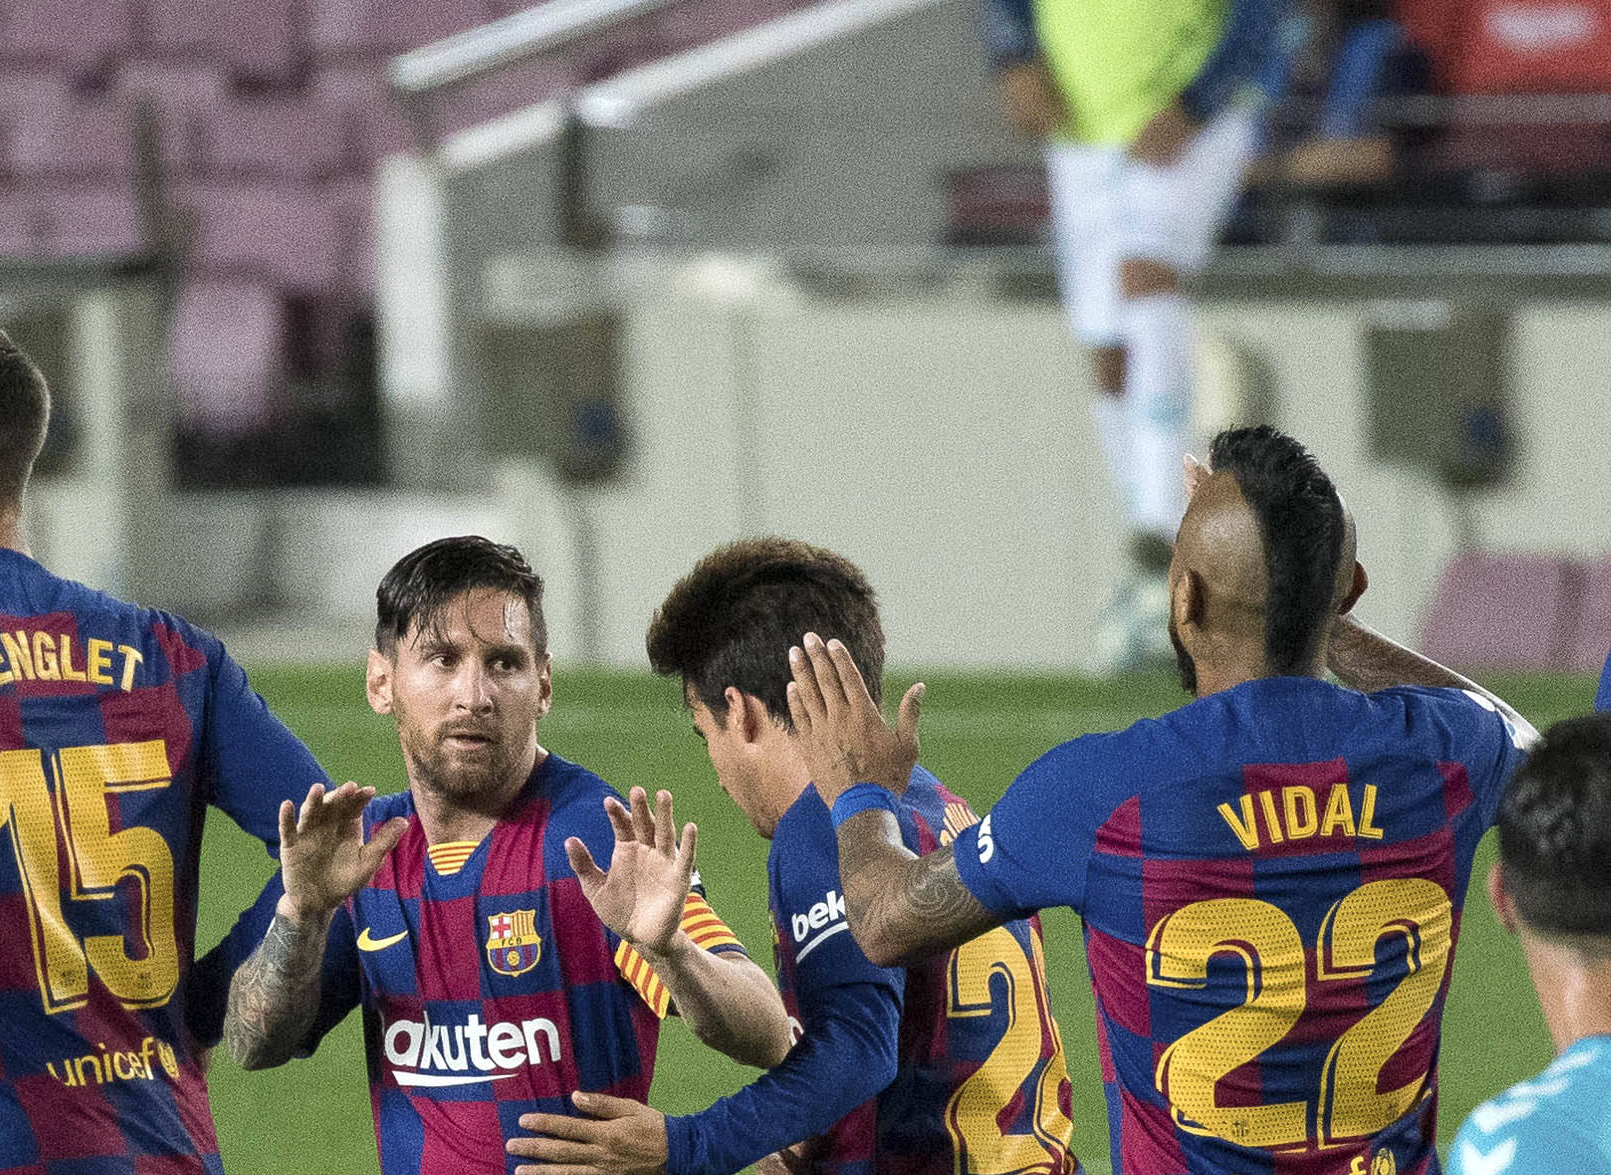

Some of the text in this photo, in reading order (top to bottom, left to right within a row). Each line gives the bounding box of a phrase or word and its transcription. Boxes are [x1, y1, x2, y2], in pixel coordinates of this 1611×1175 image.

[1217, 783, 1385, 851] VIDAL
[792, 890, 845, 942] bek
[379, 1010, 561, 1071] akuten
[1145, 878, 1453, 1154] 22
[45, 1036, 155, 1087] unicef
